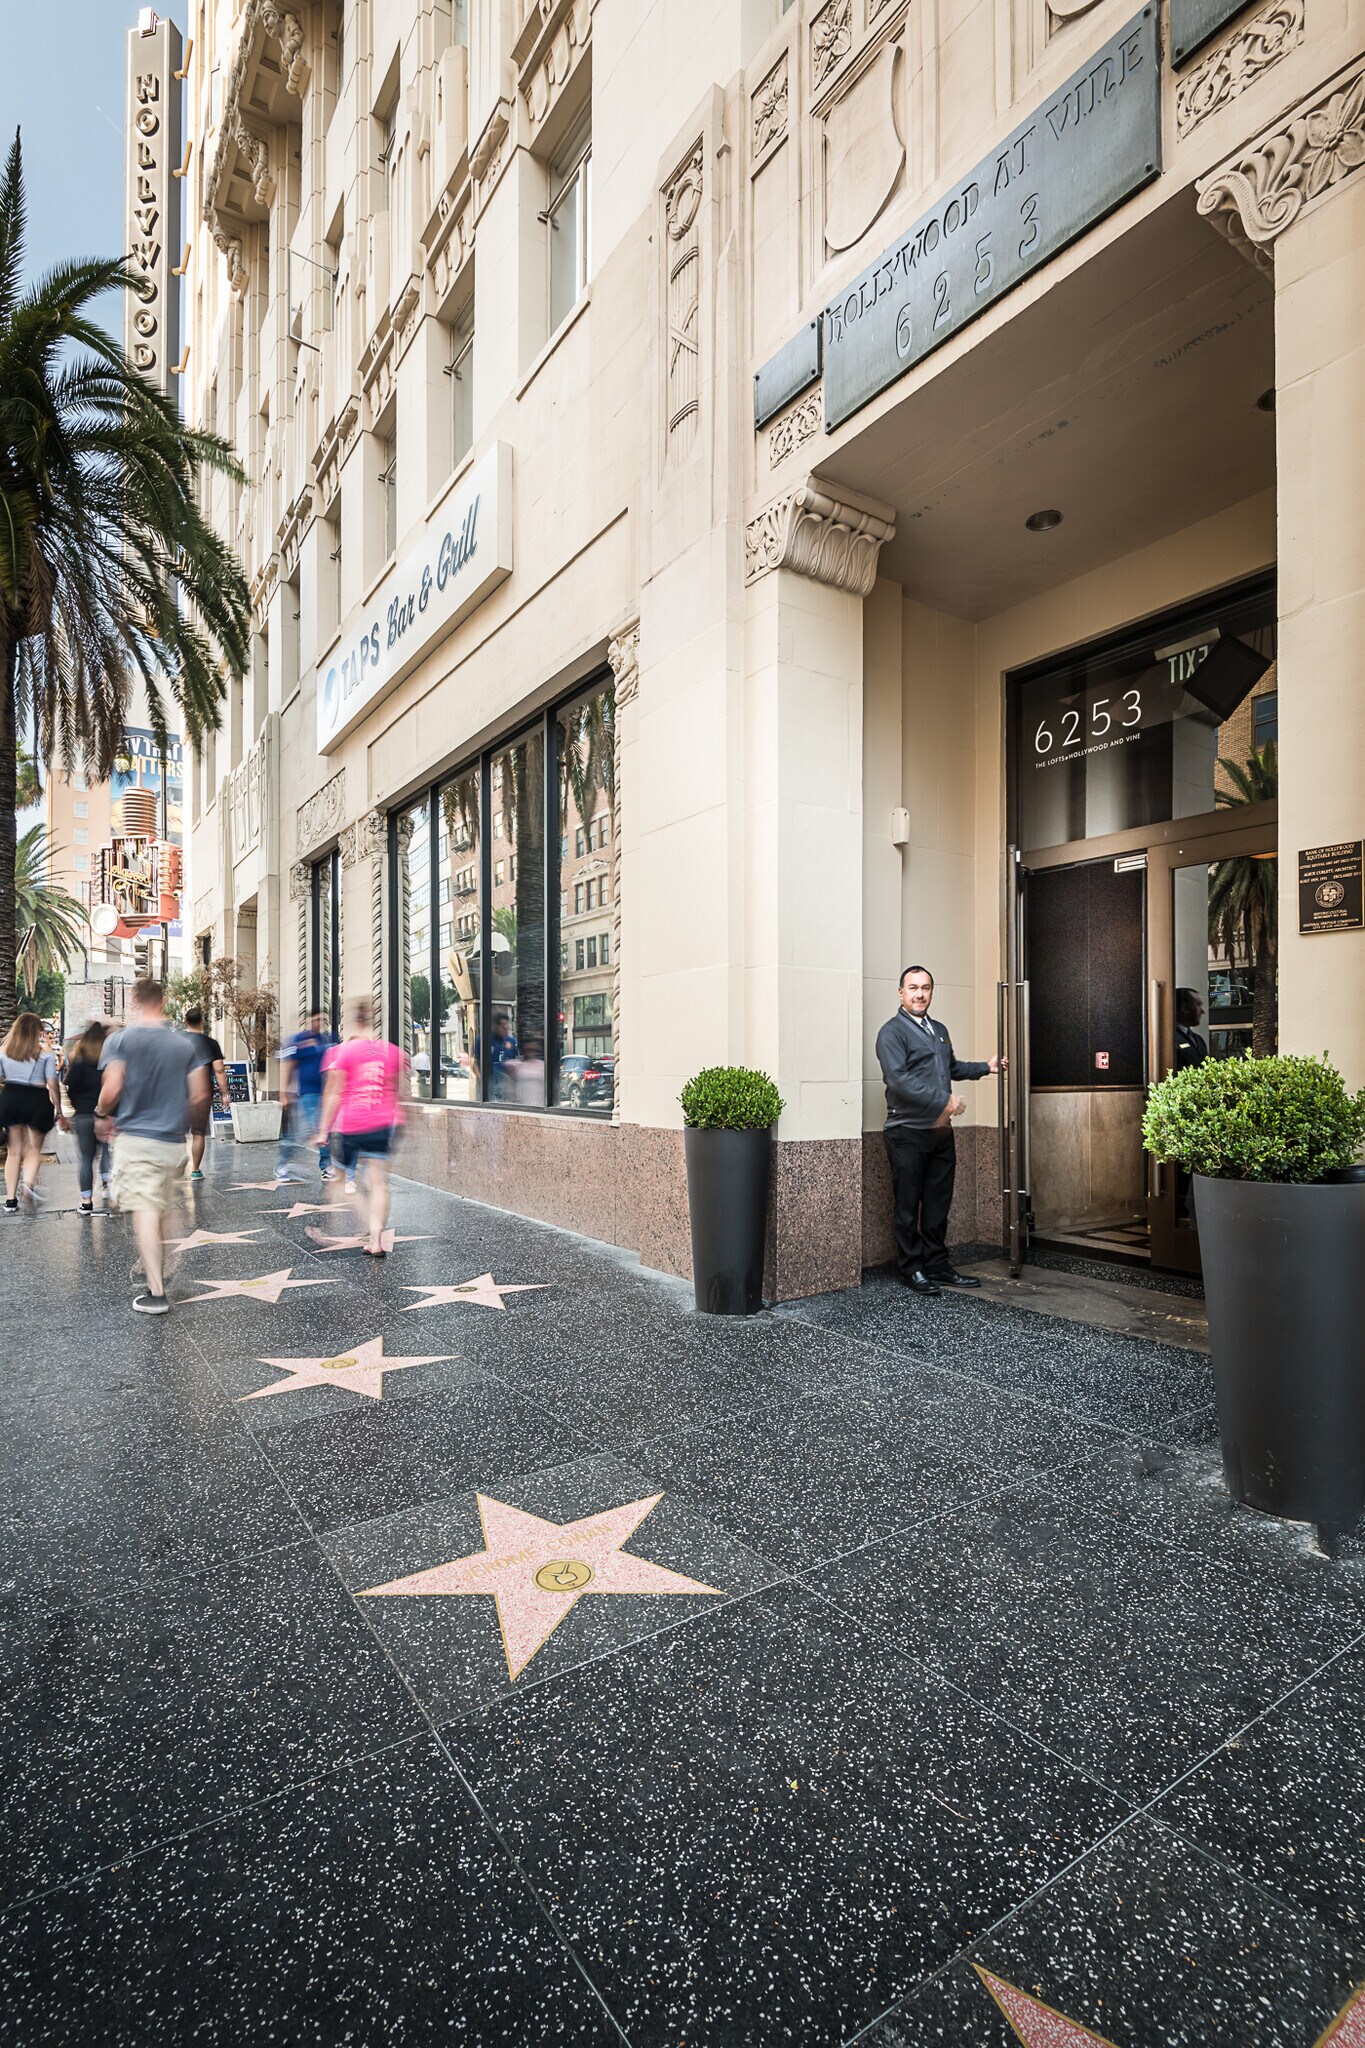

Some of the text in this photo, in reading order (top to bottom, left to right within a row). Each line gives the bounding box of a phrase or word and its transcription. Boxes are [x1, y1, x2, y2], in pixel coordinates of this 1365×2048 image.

[828, 27, 1144, 344] HOLLYWOOD AT VINE
[341, 493, 480, 700] TAPS Bar & Grill
[143, 739, 181, 760] THT
[1034, 689, 1142, 754] 6253
[1035, 762, 1046, 770] THE
[1110, 737, 1124, 747] AND
[1125, 732, 1141, 742] VINE
[130, 755, 184, 779] ATTRS
[463, 1522, 614, 1582] JEROME COWAN
